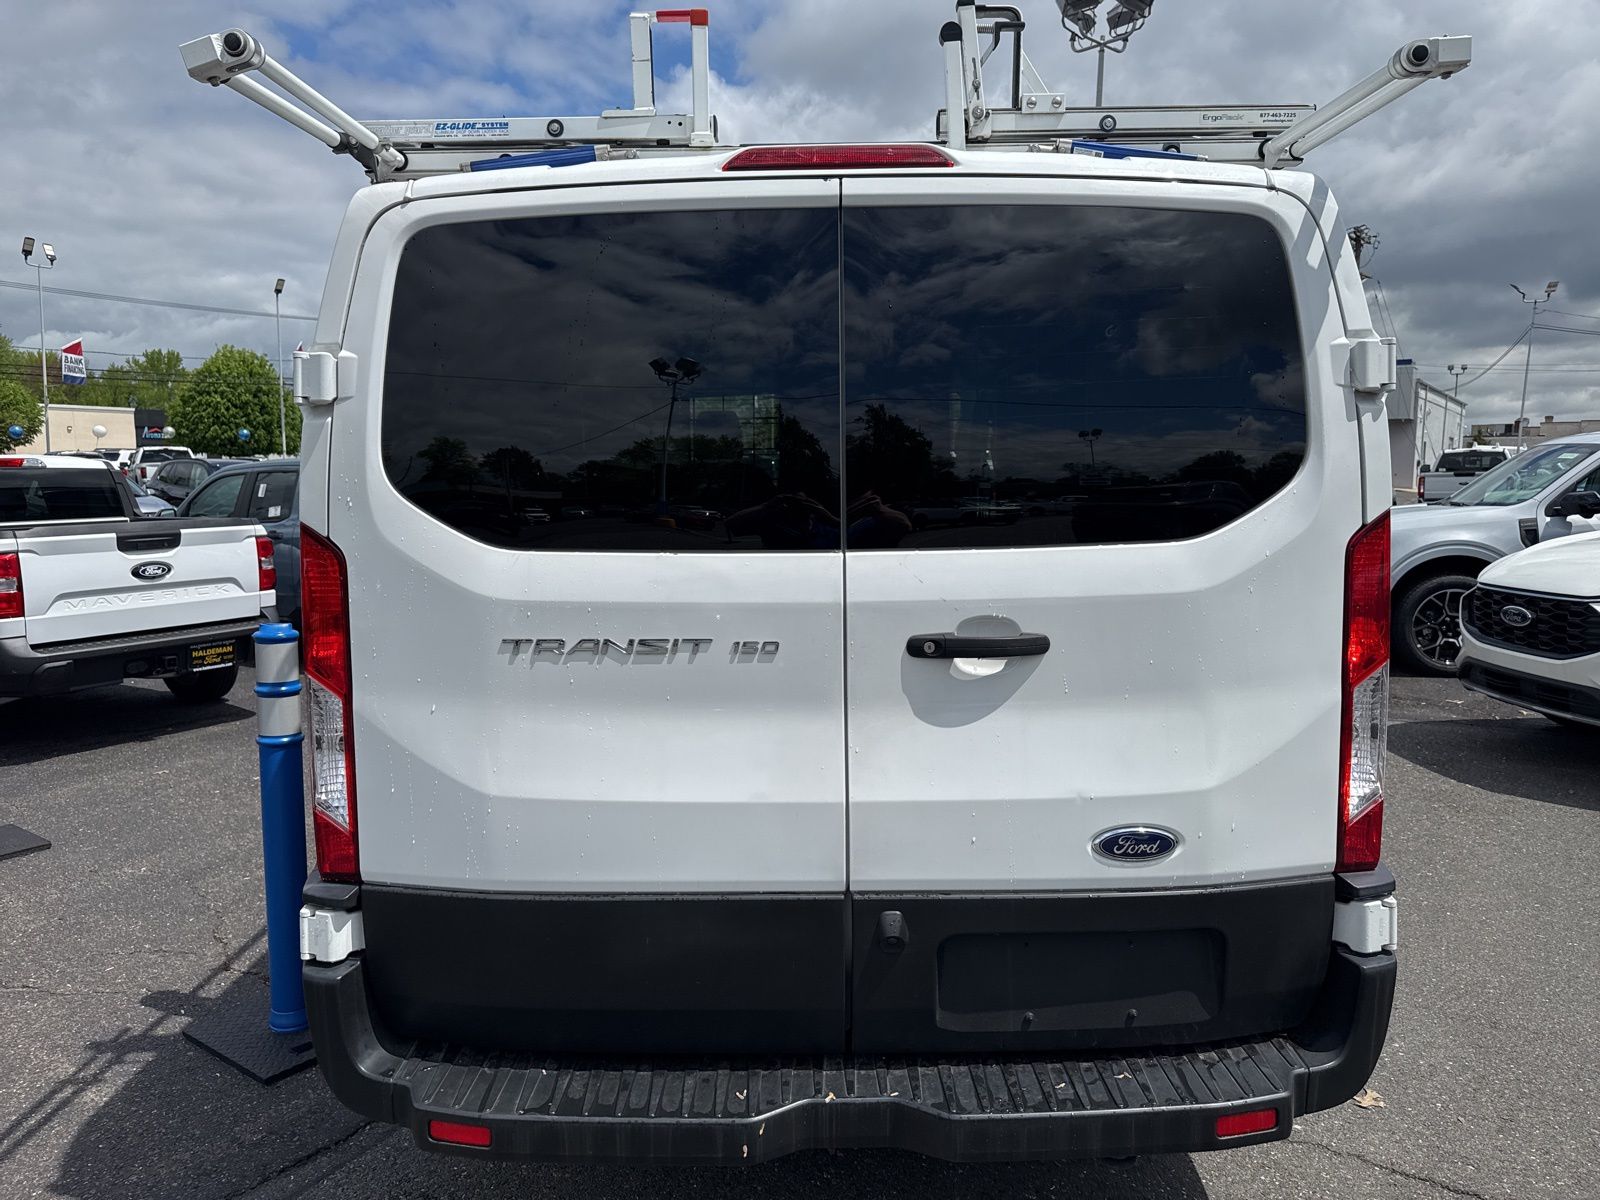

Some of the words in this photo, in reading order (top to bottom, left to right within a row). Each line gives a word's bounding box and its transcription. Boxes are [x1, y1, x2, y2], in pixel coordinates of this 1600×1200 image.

[1202, 113, 1245, 122] ErgoRack
[435, 122, 478, 130] EZ-GLIDE
[64, 355, 83, 366] BANK
[145, 566, 163, 575] Ford
[64, 585, 231, 611] MAVERICK
[192, 645, 233, 657] HALDEMAN
[500, 638, 714, 657] TRANSIT
[730, 641, 780, 656] 150
[1113, 835, 1161, 854] Ford
